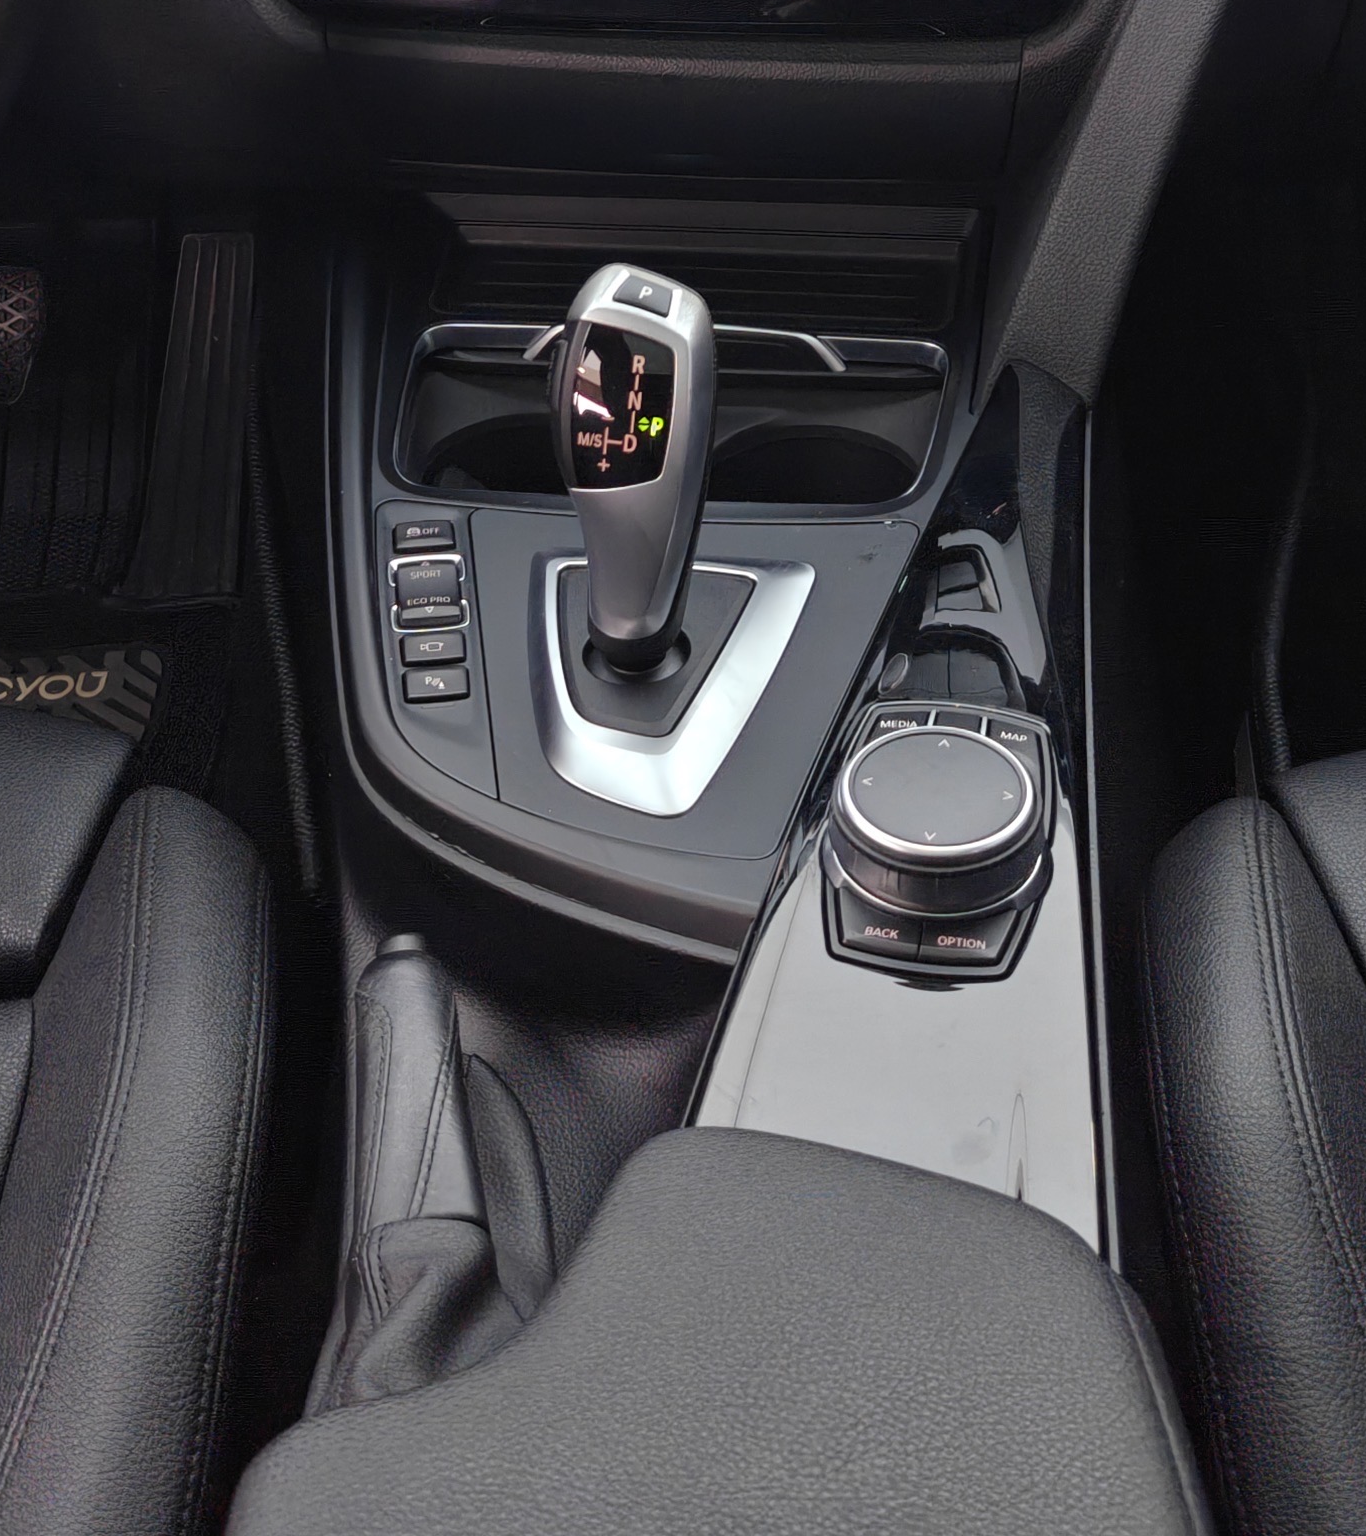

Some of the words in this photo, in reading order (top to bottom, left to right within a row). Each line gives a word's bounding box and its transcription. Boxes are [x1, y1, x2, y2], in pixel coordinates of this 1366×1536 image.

[638, 286, 653, 299] P
[631, 355, 645, 374] R
[627, 391, 642, 410] N
[650, 417, 664, 437] P
[577, 431, 602, 448] M/S
[622, 434, 638, 452] D
[410, 569, 442, 580] SPORT
[407, 597, 427, 606] ECO
[880, 719, 918, 728] MEDIA
[1000, 731, 1027, 742] MAP
[864, 925, 899, 940] BACK
[937, 935, 986, 950] OPTION
